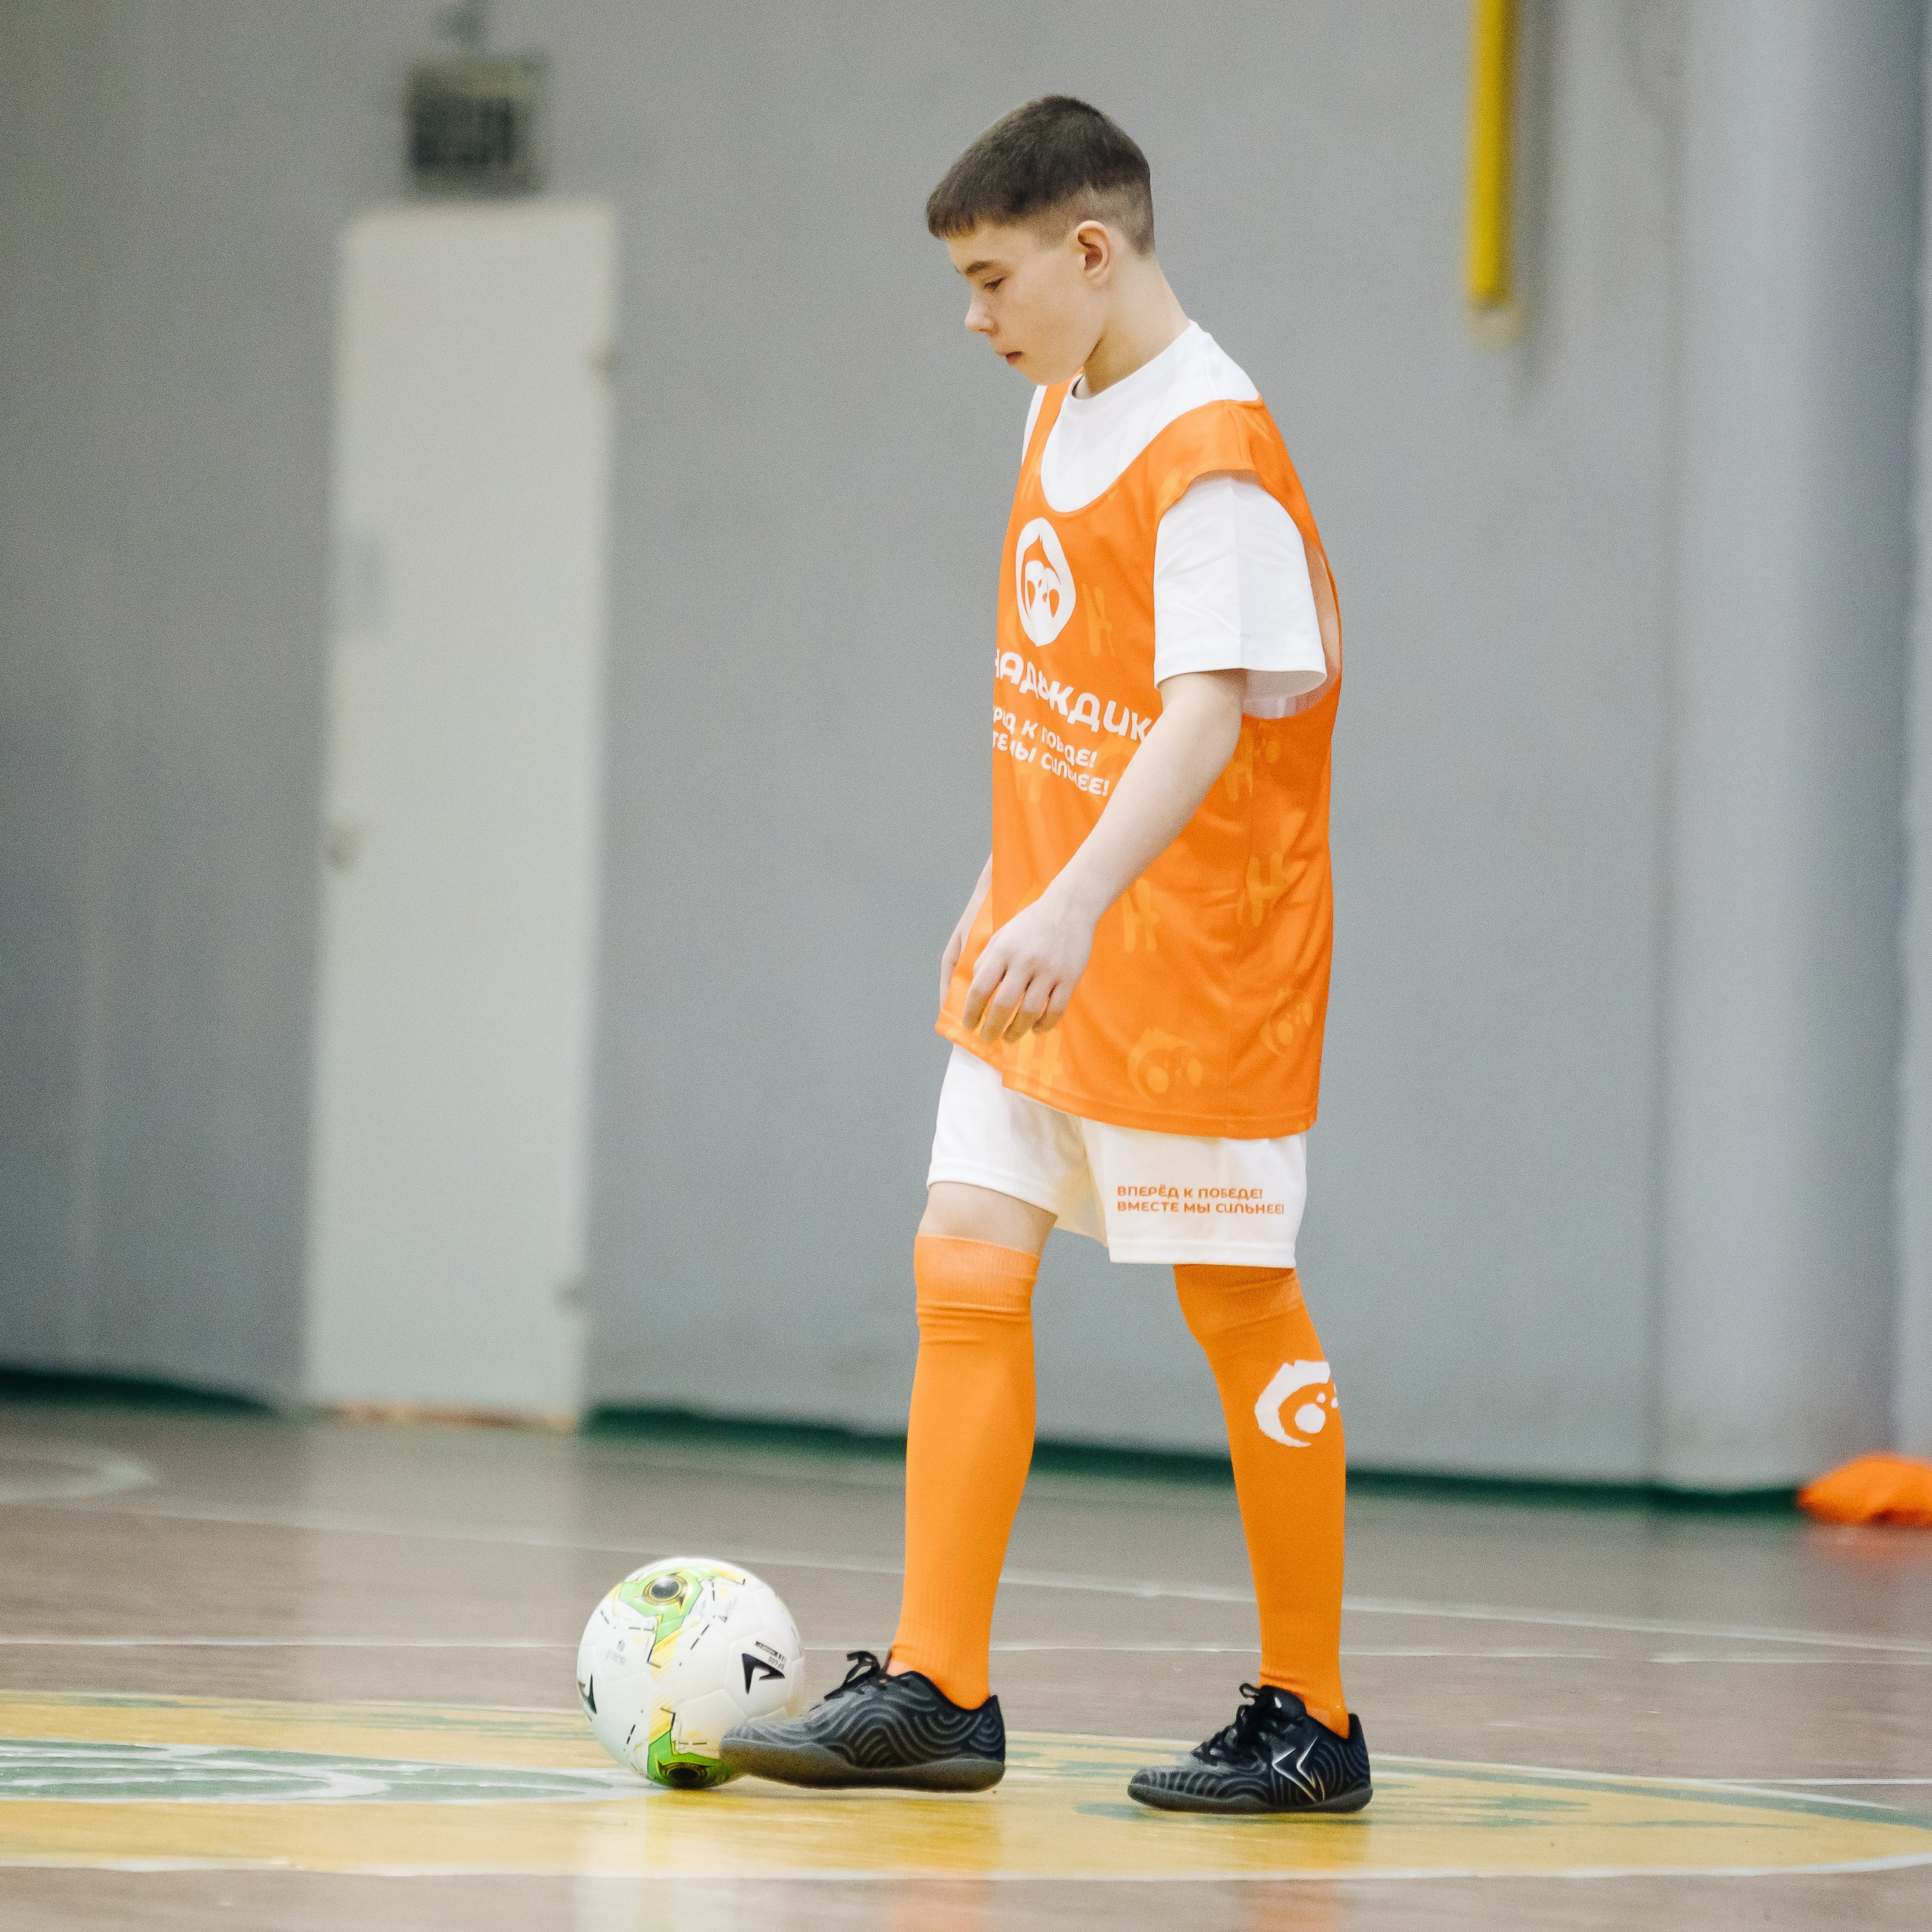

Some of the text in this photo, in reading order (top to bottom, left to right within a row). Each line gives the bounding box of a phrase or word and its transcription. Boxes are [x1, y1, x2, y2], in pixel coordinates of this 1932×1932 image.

[1020, 718, 1039, 740] К
[1117, 1183, 1263, 1201] ВПЕРЁД К ПОБЕДЕ!
[1117, 1201, 1284, 1215] ВМЕСТЕ МЫ СИЛЬНЕЕ!
